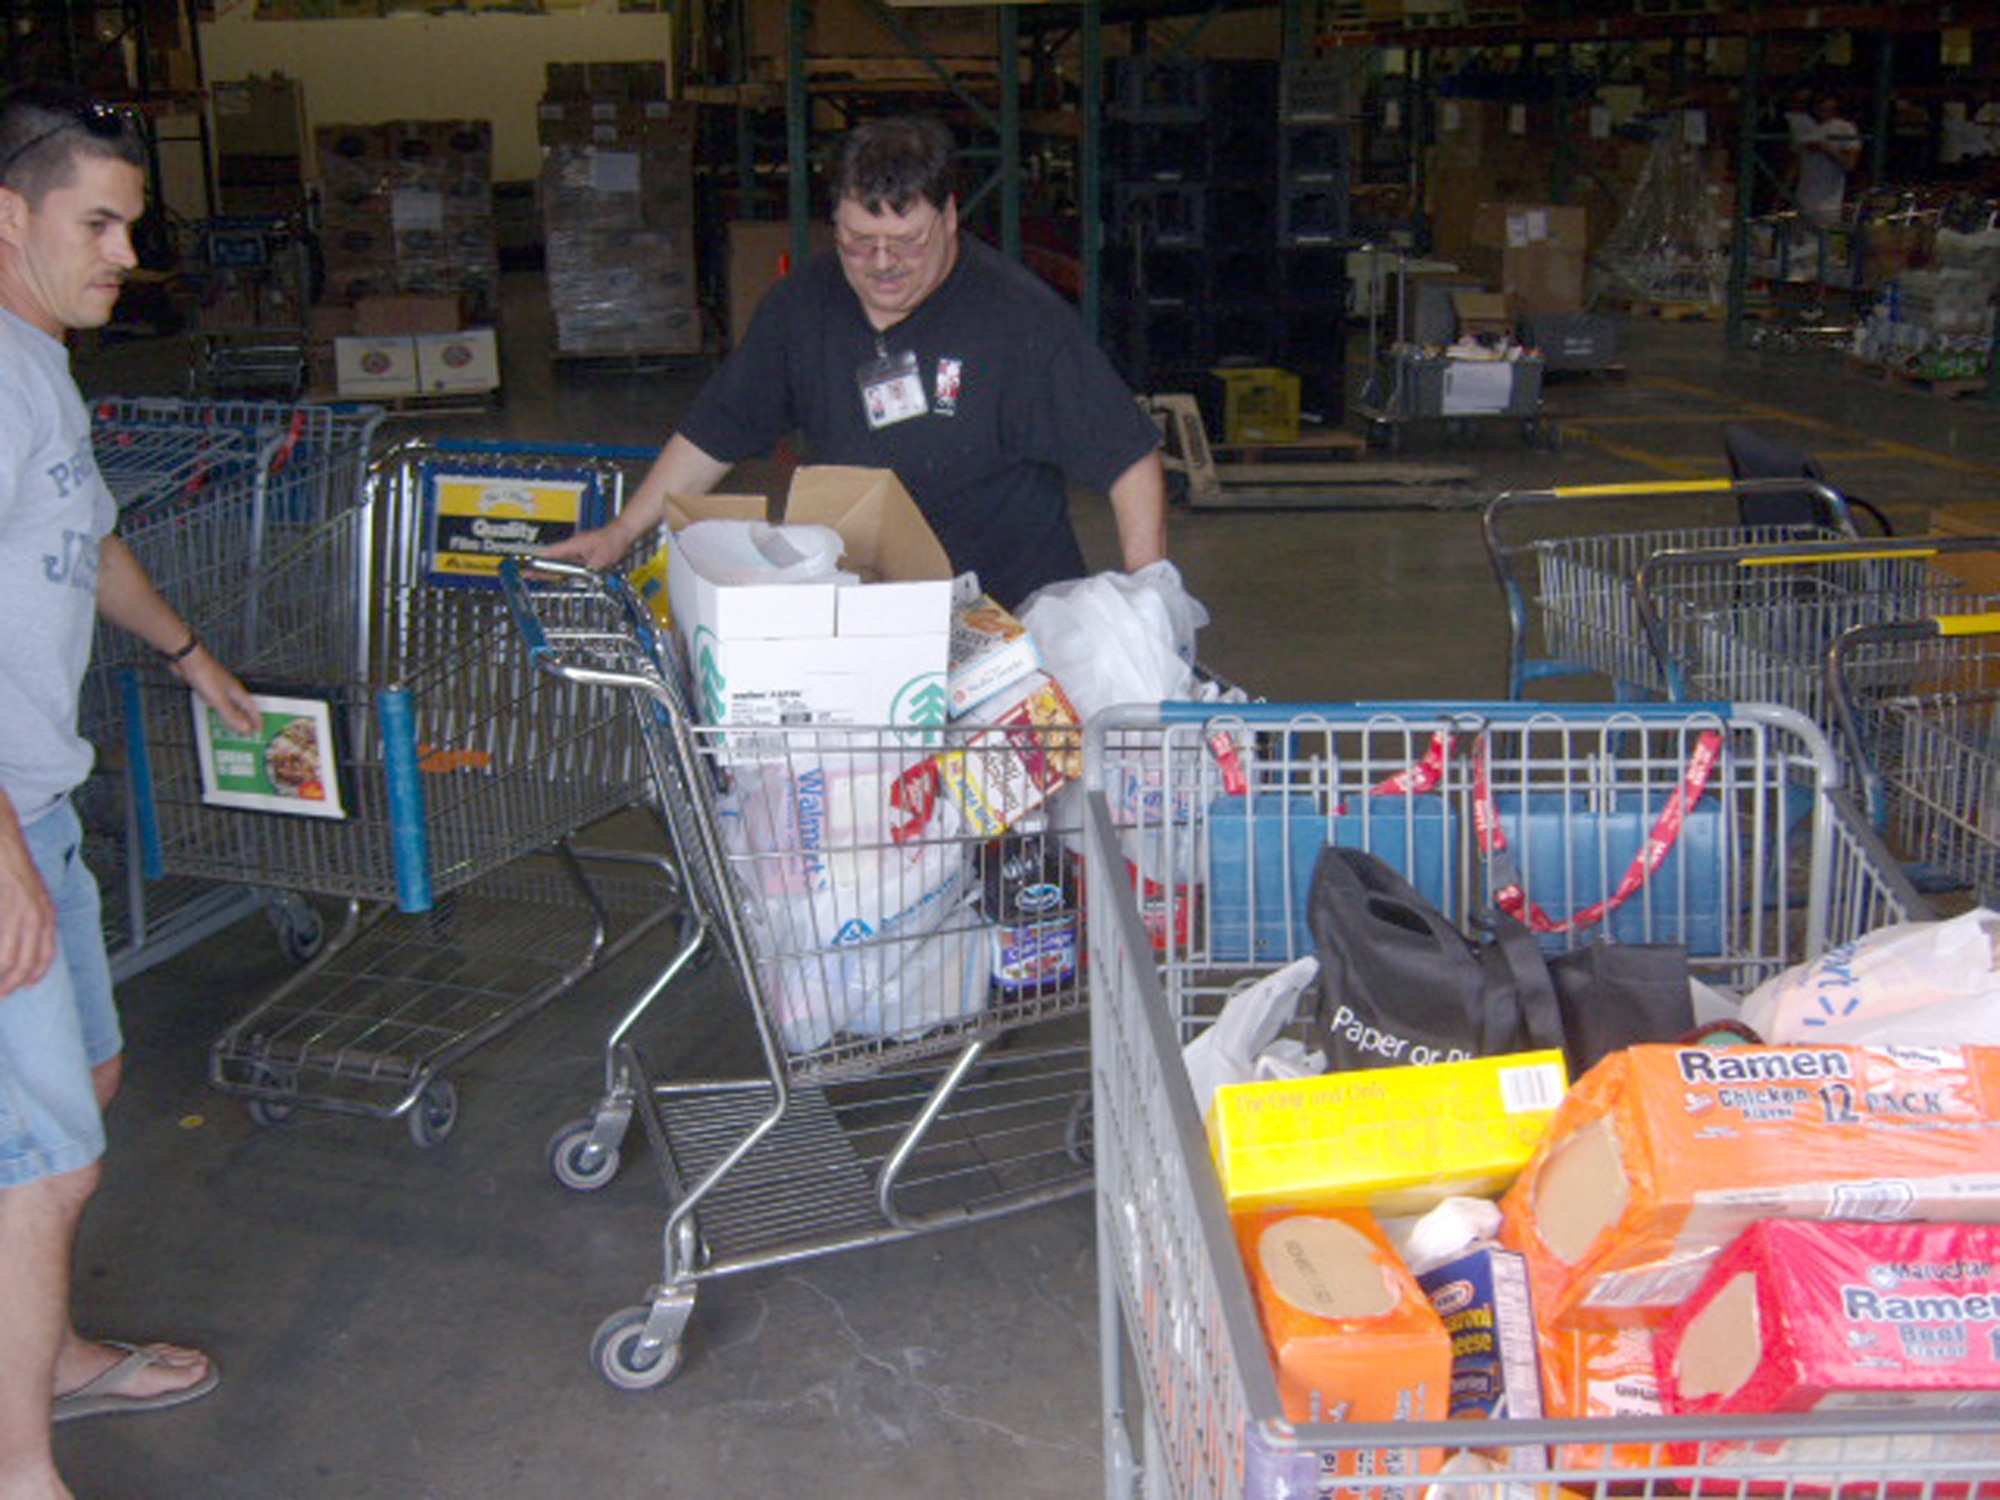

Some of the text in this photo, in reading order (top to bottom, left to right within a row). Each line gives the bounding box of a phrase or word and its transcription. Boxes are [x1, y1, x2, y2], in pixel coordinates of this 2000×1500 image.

[472, 518, 540, 542] Quality
[1330, 1005, 1409, 1059] Paper
[1410, 1045, 1444, 1067] or
[1680, 1051, 1850, 1082] Ramen
[1718, 1086, 1811, 1107] Chicken
[1818, 1083, 1860, 1124] 12
[1900, 1324, 1967, 1343] Beef
